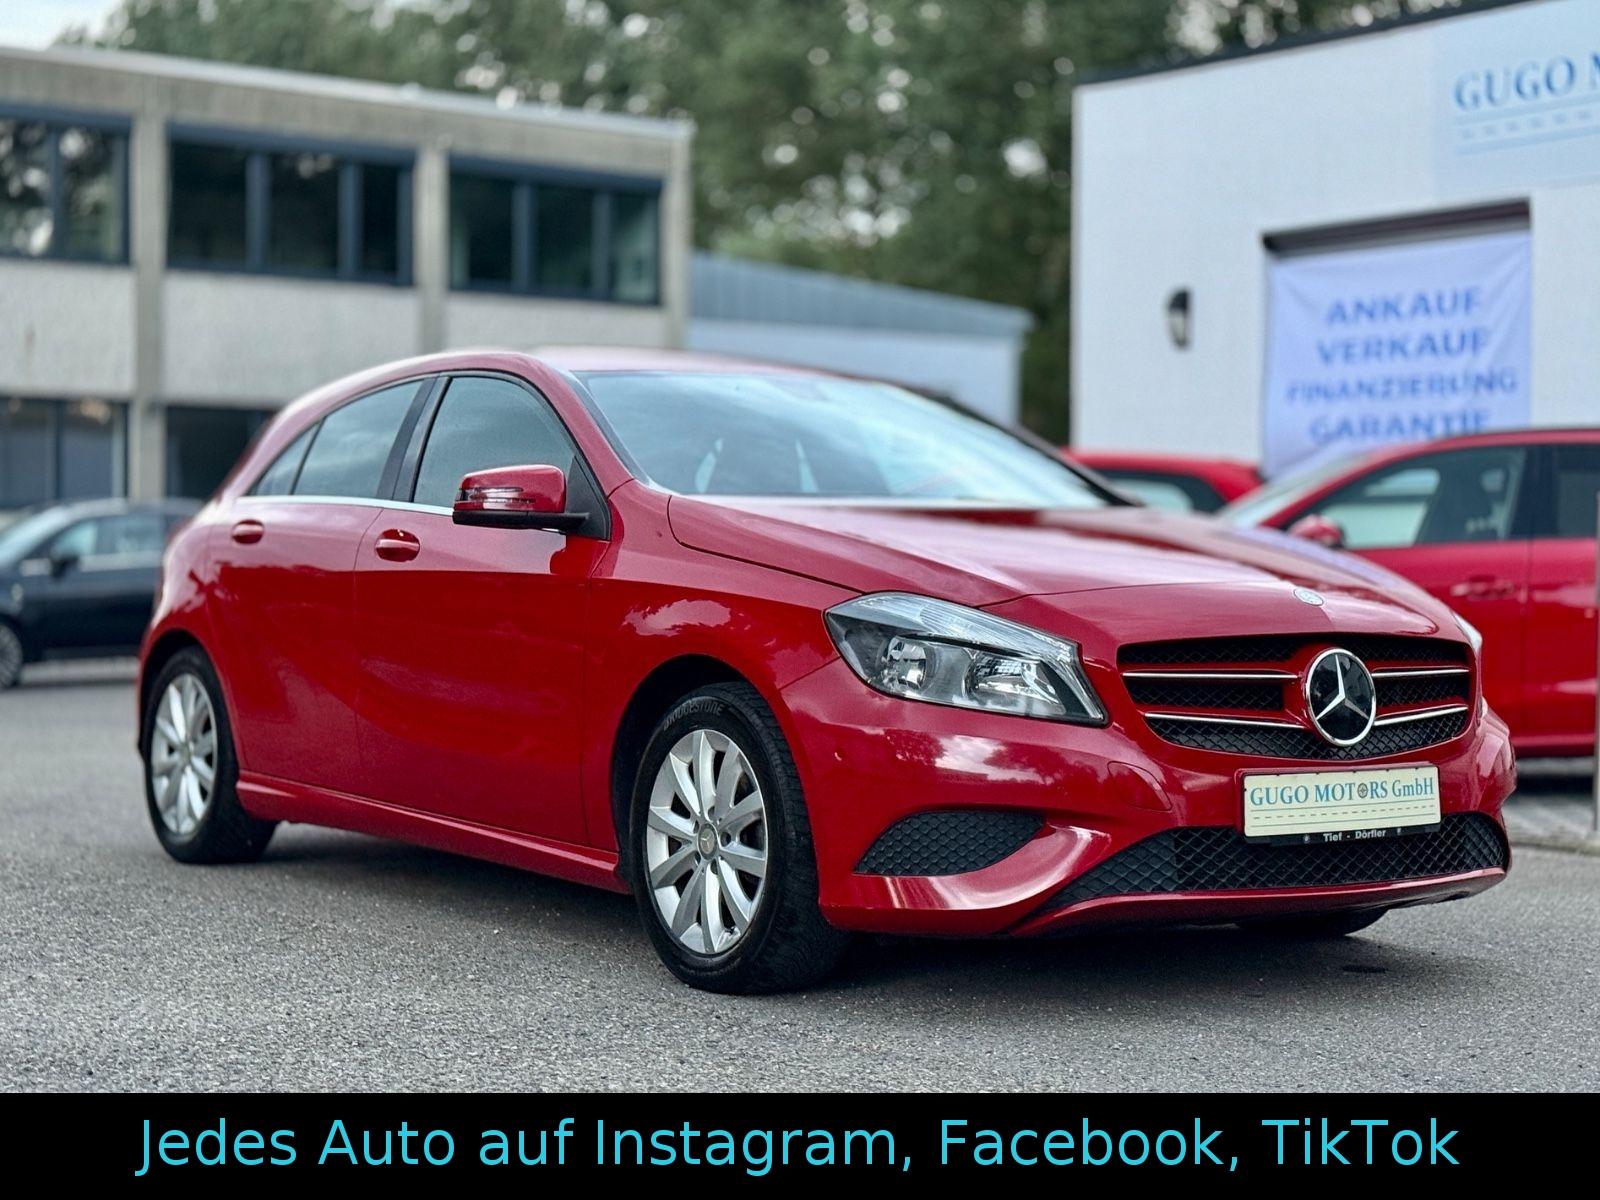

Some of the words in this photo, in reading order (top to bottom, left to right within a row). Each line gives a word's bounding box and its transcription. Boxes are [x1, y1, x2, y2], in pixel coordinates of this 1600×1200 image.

[1453, 55, 1577, 111] GUGO
[1325, 286, 1481, 325] ANKAUF
[1316, 328, 1488, 366] VERKAUF
[1286, 368, 1518, 405] FINANZIERUNG
[1250, 785, 1309, 806] GUGO
[1391, 777, 1434, 798] GmbH
[1323, 832, 1342, 843] Tief
